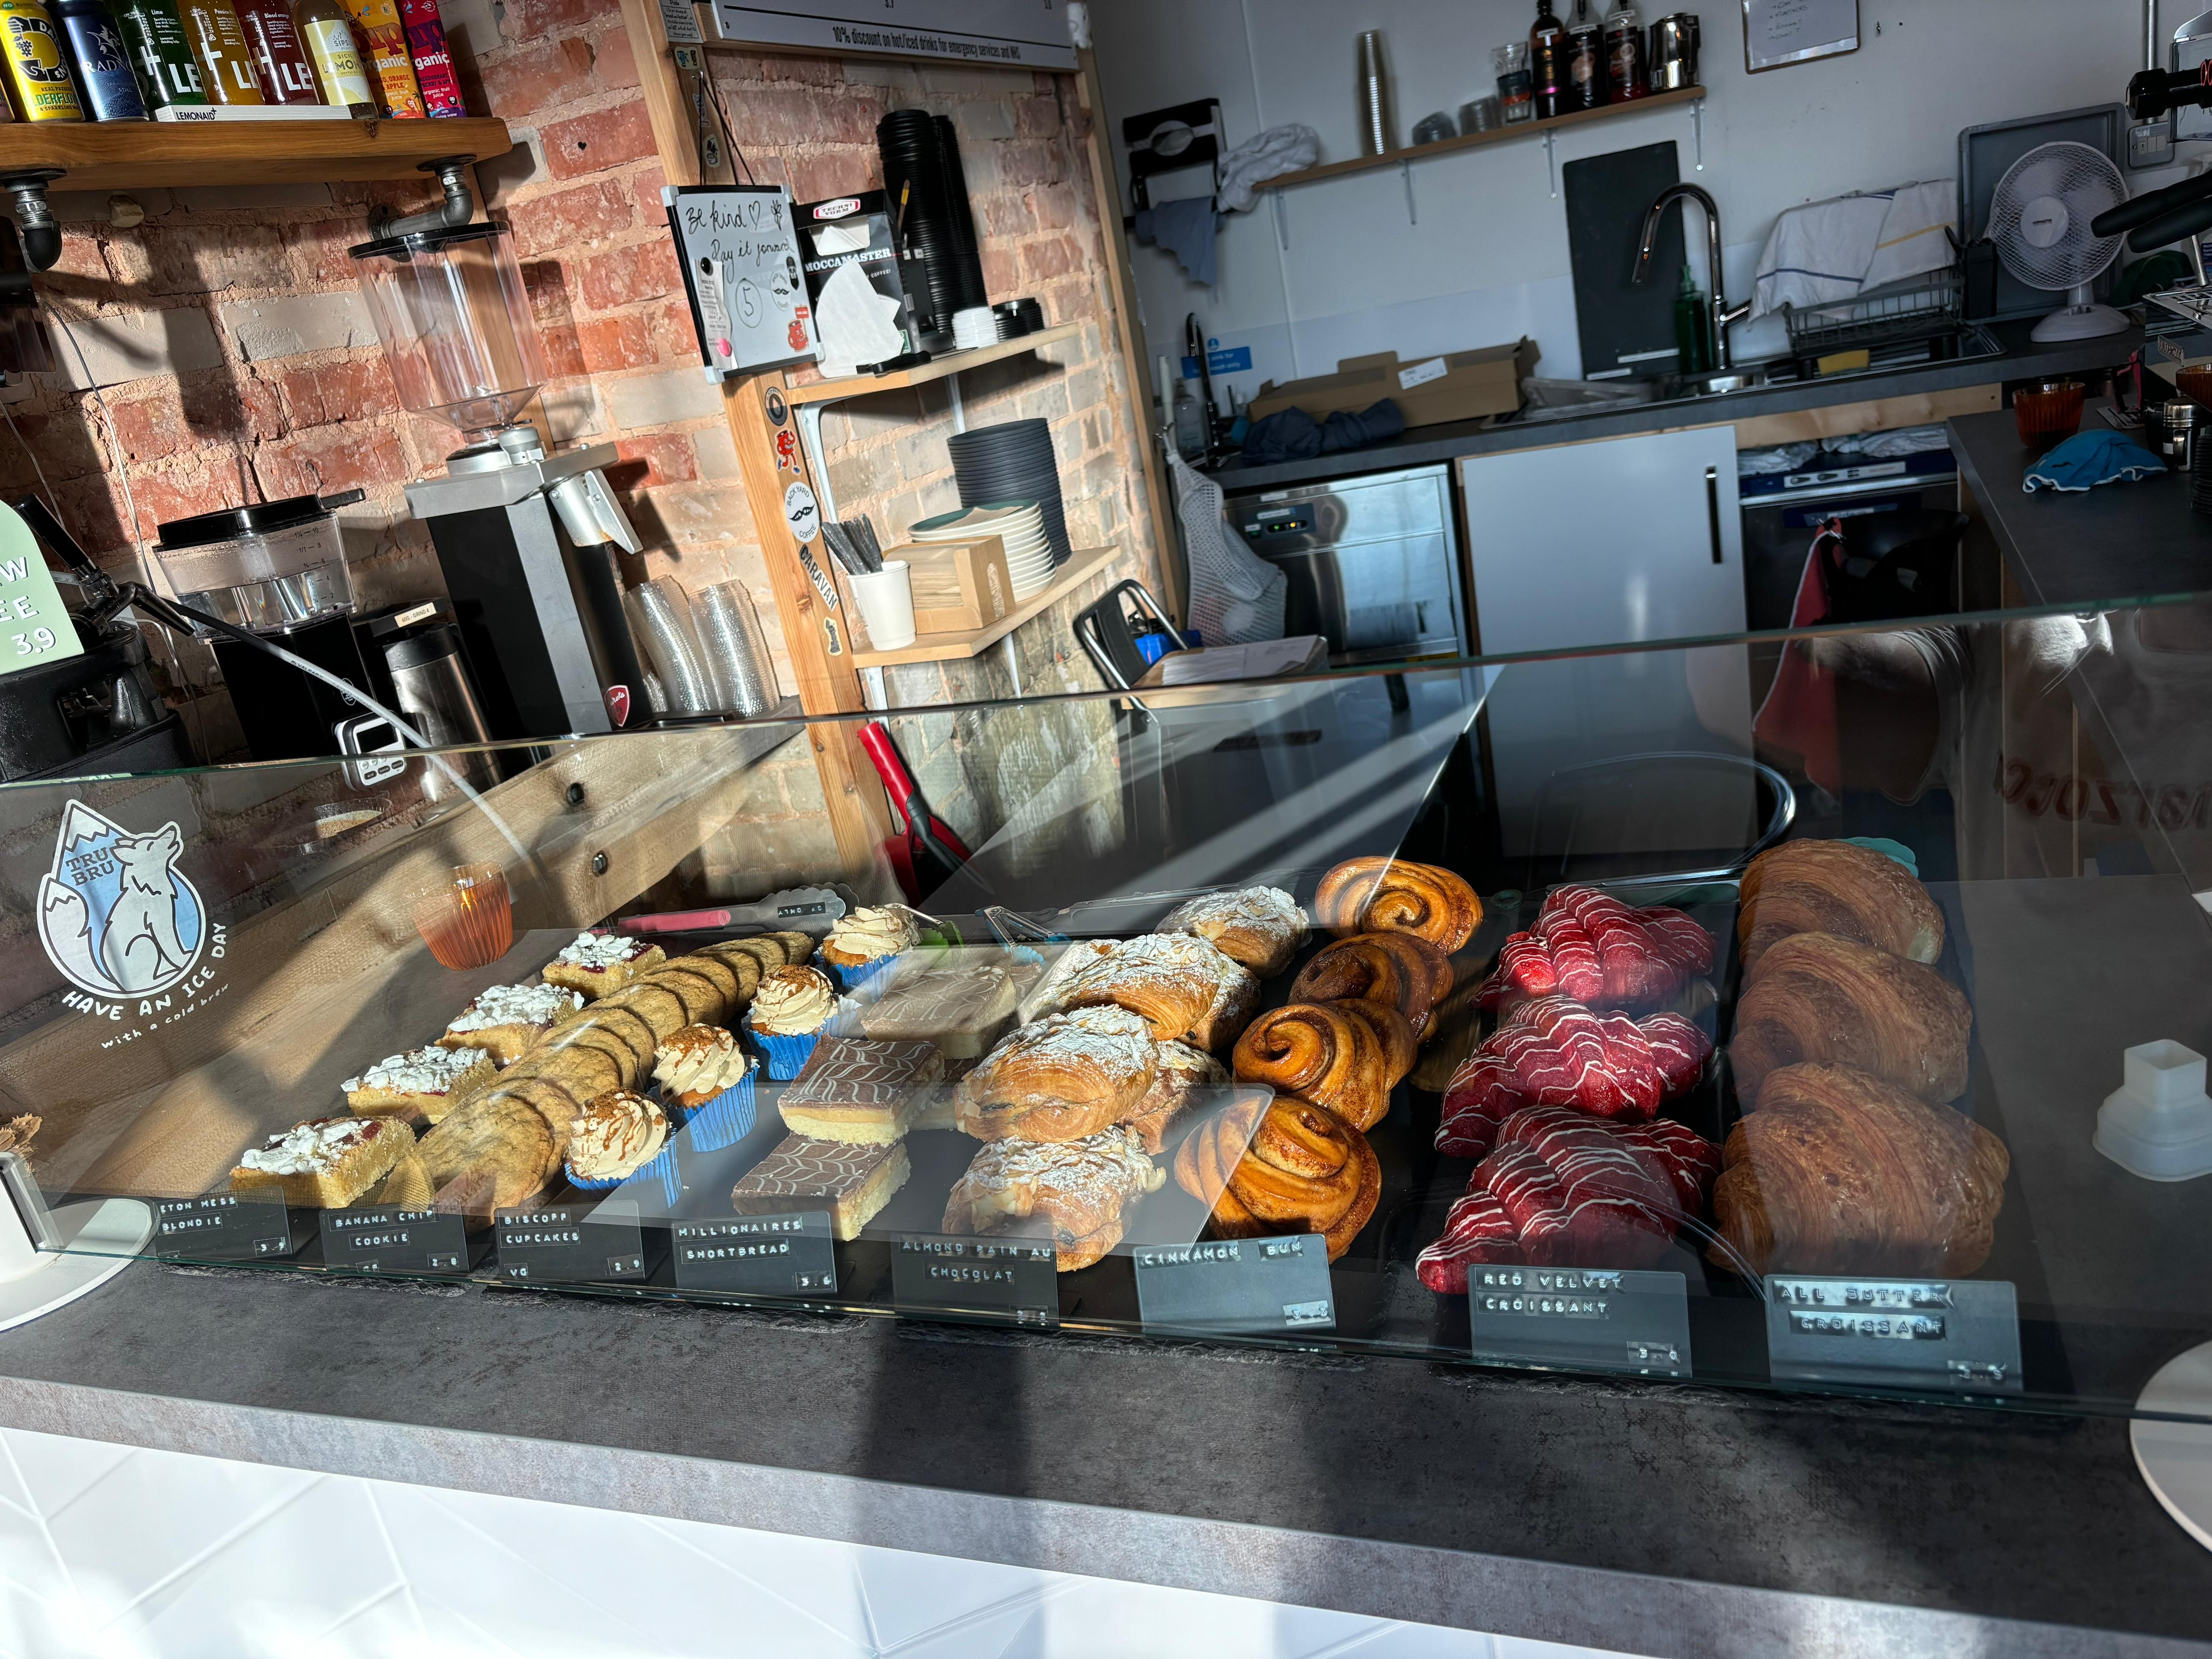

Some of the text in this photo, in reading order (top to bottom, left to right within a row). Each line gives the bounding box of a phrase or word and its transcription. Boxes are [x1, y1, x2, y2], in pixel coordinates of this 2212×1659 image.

[832, 26, 851, 44] 10%
[851, 28, 881, 46] discount
[882, 34, 891, 47] on
[919, 35, 938, 51] drinks
[938, 38, 947, 53] for
[948, 42, 978, 57] emergency
[978, 42, 1001, 57] services
[1000, 45, 1010, 59] and
[686, 200, 747, 235] Be kind
[738, 240, 752, 257] it
[743, 286, 754, 317] 5
[800, 544, 837, 610] CARAVAN
[413, 609, 426, 619] GRIND
[11, 626, 57, 655] 3.9
[65, 847, 110, 873] TRU
[71, 861, 115, 887] BRU
[62, 922, 227, 1020] HAVE AN ICE DAY
[101, 1030, 143, 1049] with
[165, 1004, 195, 1024] cold
[200, 983, 229, 1006] brew
[159, 1197, 236, 1214] ETON MESS
[162, 1216, 222, 1232] BLONDIE
[334, 1210, 433, 1228] BANANA CHIP
[504, 1212, 567, 1225] BISCOFF
[678, 1220, 802, 1237] MILLIONAIRES
[355, 1233, 409, 1246] COOKIE
[506, 1232, 580, 1244] CUPCAKES
[686, 1243, 789, 1260] SHORTBREAD
[902, 1239, 1052, 1258] ALMOND PAIN AU
[1143, 1240, 1303, 1268] CINNAMON BUN
[509, 1267, 528, 1278] VG
[930, 1265, 1014, 1281] CHOCOLAT
[1483, 1272, 1623, 1290] RED VELVET
[1780, 1286, 1940, 1303] ALL BUTTER
[1484, 1298, 1608, 1314] CROISSANT
[1799, 1316, 1943, 1335] CROISSANT
